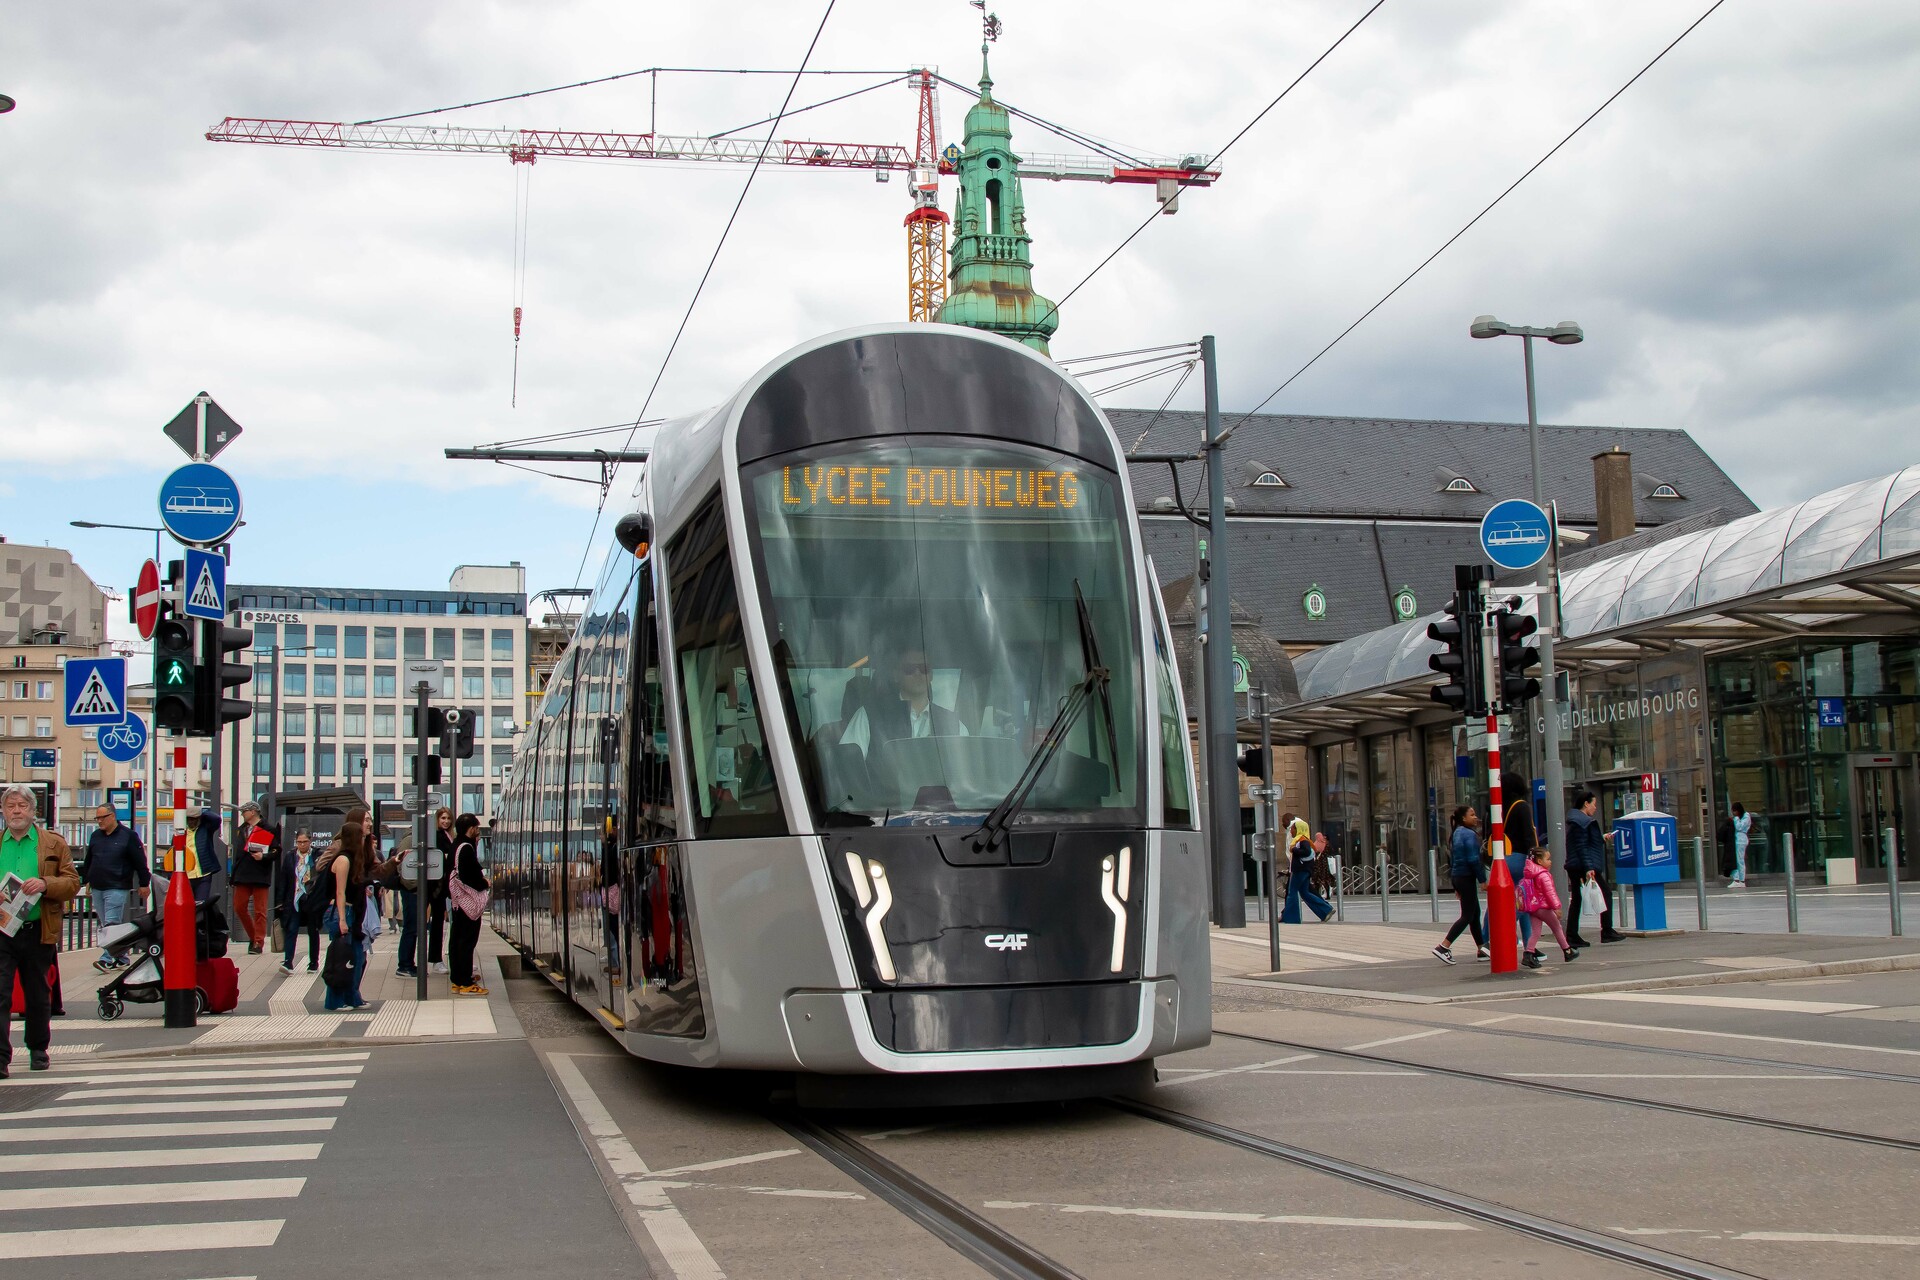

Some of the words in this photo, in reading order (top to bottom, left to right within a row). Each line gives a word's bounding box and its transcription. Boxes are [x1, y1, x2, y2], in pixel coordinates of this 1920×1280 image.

[783, 466, 891, 505] LYCEE
[906, 468, 1078, 508] BOUNEWEG
[255, 612, 301, 624] SPACES.
[1536, 712, 1568, 734] GRE
[984, 933, 1029, 952] CAF
